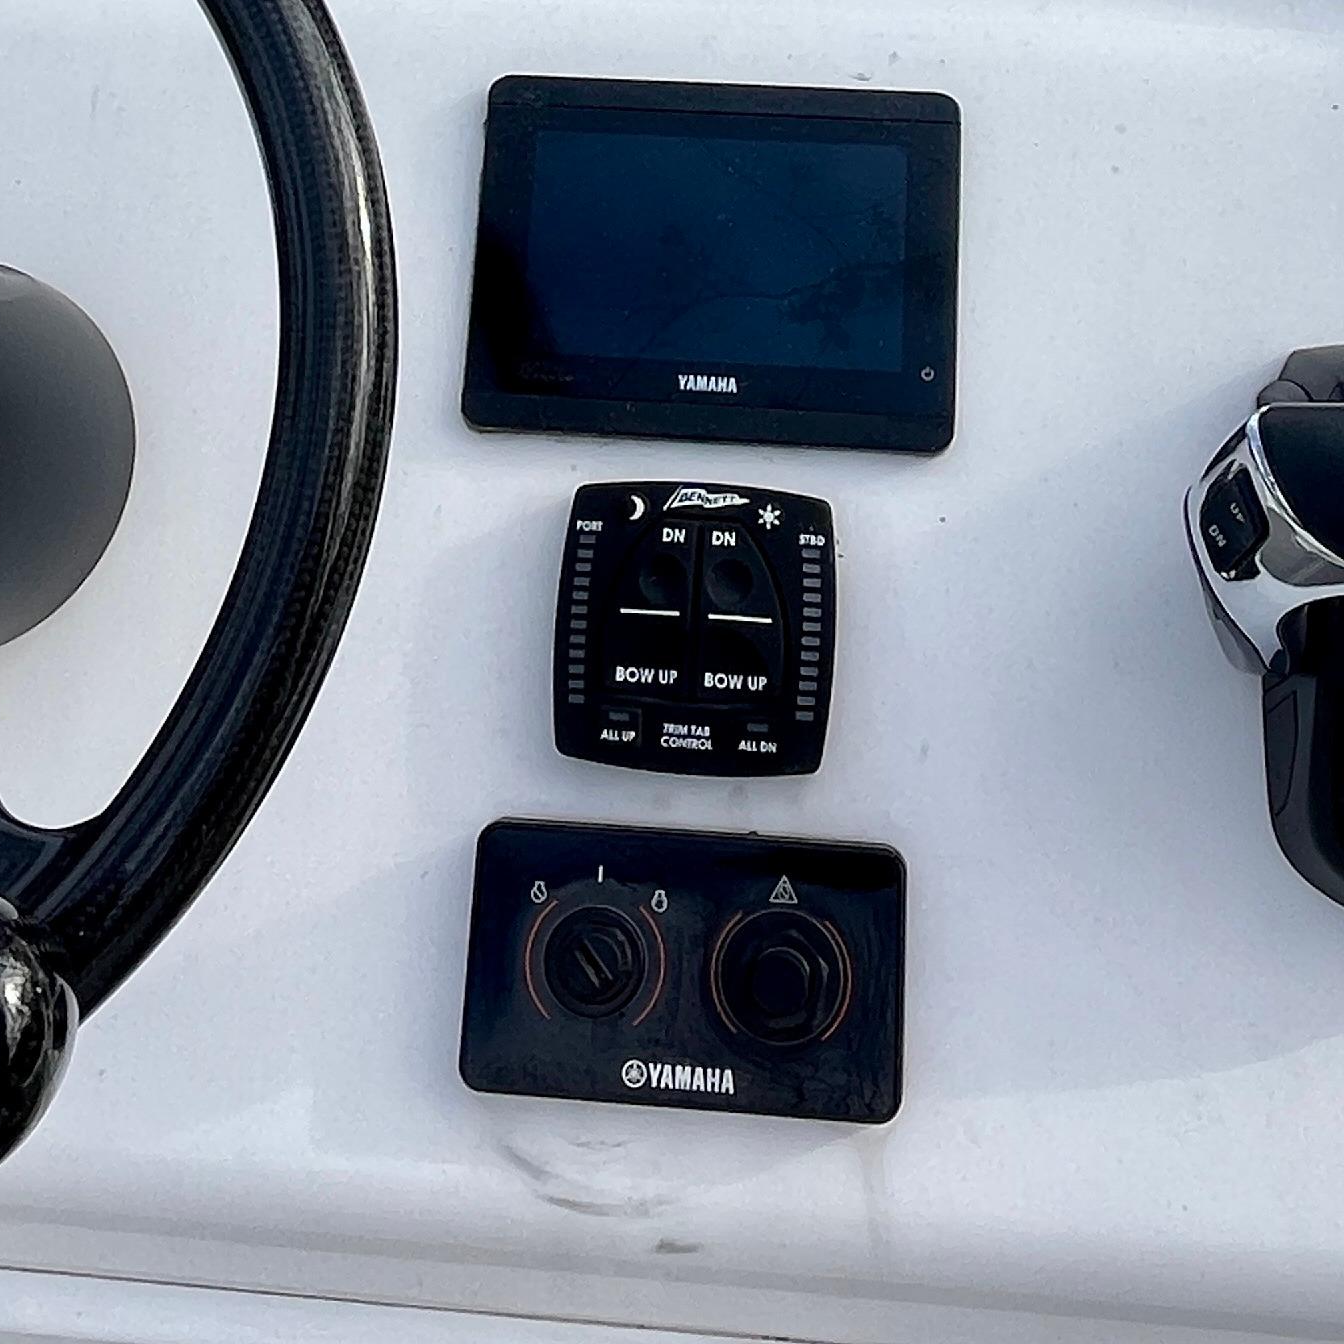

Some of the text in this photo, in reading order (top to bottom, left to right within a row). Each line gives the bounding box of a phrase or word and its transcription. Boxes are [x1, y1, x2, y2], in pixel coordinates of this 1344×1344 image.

[677, 374, 738, 394] YAMAHA
[677, 491, 736, 506] BENNETT
[576, 520, 603, 532] PORT
[662, 528, 686, 544] DN
[711, 531, 737, 547] DN
[798, 533, 826, 547] STBD
[615, 666, 678, 685] BOW UP
[704, 672, 768, 691] BOW UP
[600, 729, 636, 743] ALL UP
[663, 723, 711, 737] TRIM TAB
[660, 736, 713, 750] CONTROL
[738, 739, 777, 754] ALL DN
[648, 1062, 736, 1095] YAMAHA
